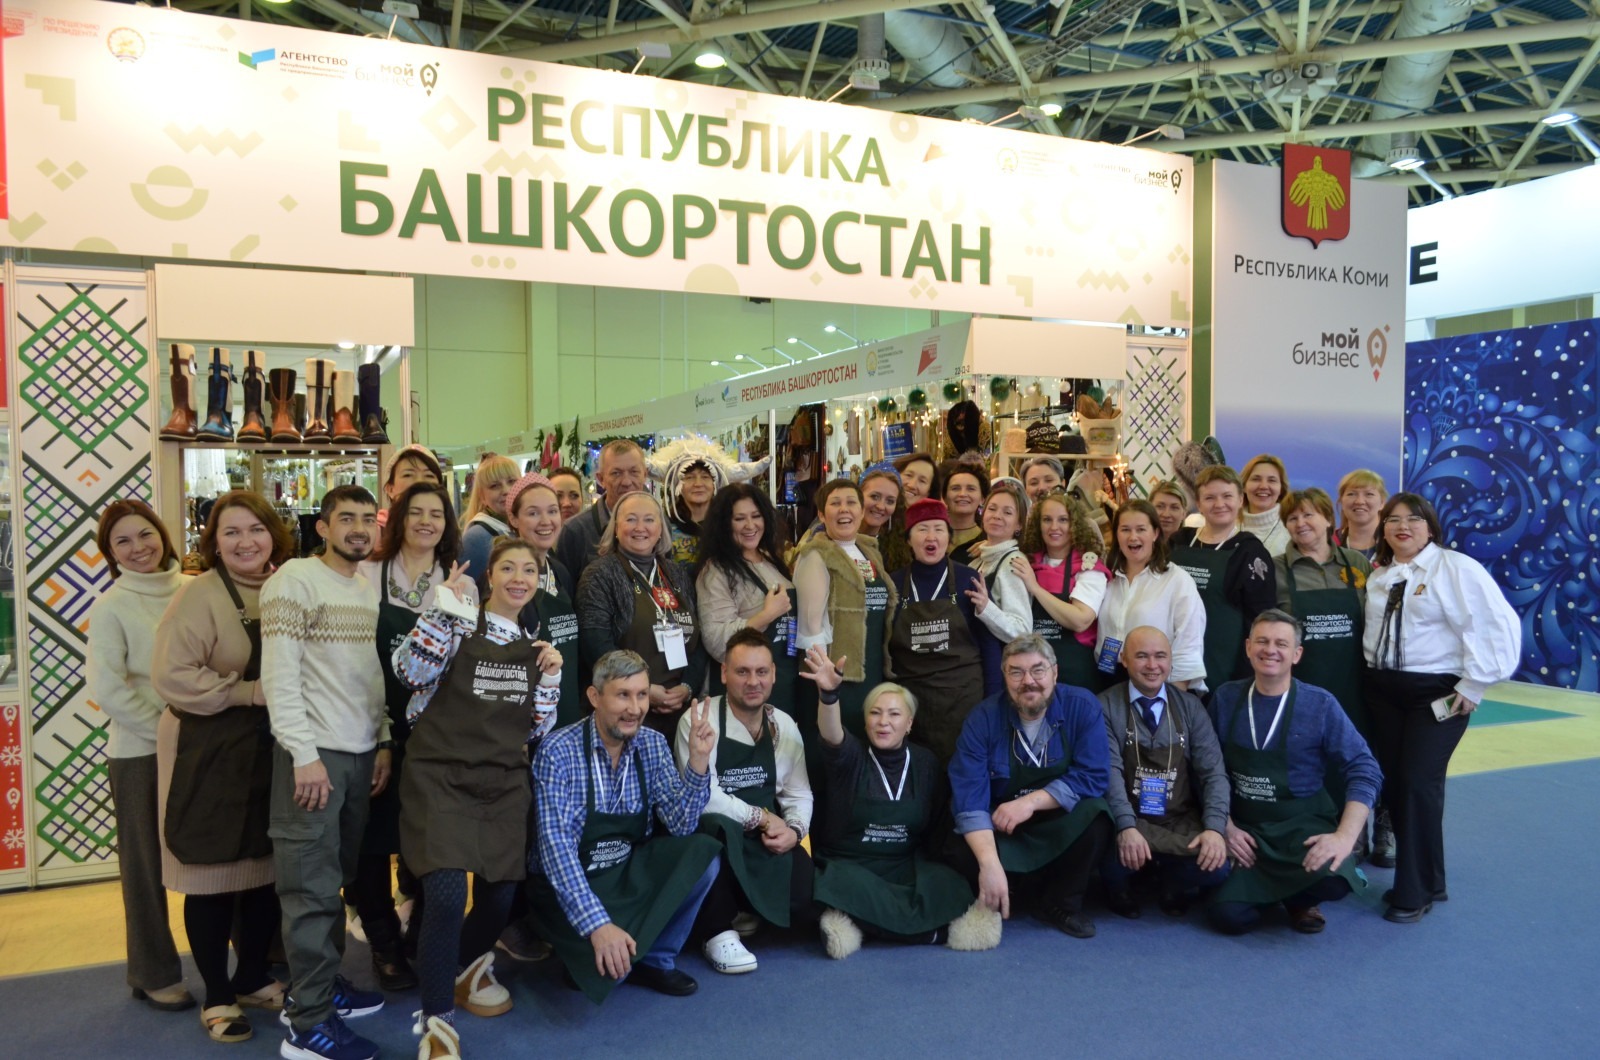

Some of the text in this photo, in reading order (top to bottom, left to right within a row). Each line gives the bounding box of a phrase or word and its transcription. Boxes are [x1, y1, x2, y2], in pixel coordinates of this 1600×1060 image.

[280, 51, 348, 66] АГЕНТСТВО
[487, 86, 890, 187] РЕСПУБЛИКА
[1134, 174, 1168, 188] бизнес
[1148, 169, 1168, 180] мой
[340, 160, 990, 285] БАШКОРТОСТАН
[1320, 327, 1360, 351] мой
[1292, 335, 1360, 369] бизнес
[741, 382, 787, 402] РЕСПУБЛИКА
[788, 363, 857, 393] БАШКОРТОСТАН
[474, 665, 528, 681] БАШКОРТОСТАН
